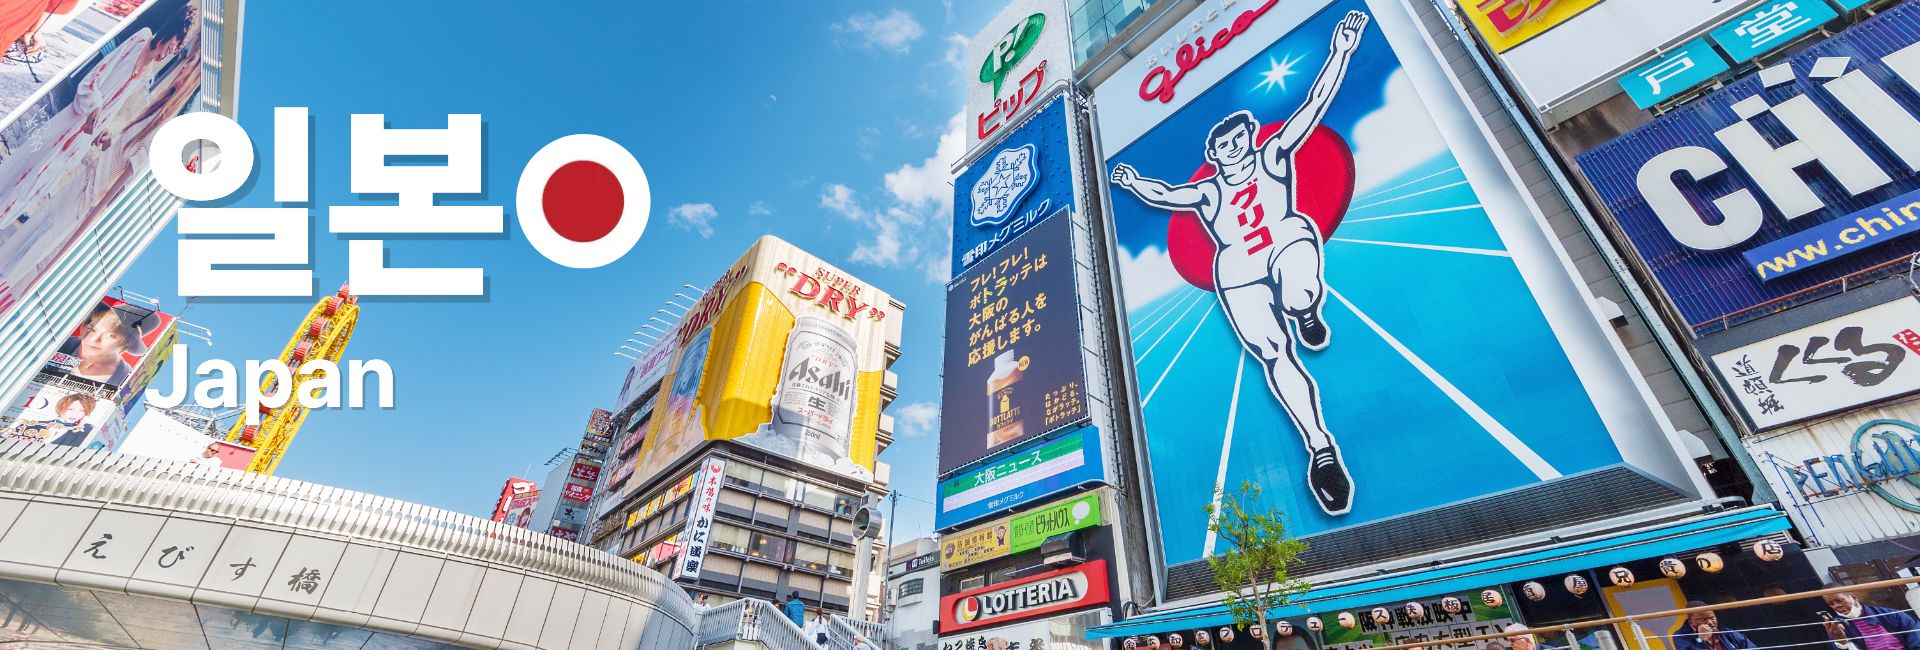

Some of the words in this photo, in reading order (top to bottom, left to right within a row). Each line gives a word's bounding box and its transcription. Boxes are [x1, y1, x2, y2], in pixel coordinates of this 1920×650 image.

[977, 59, 1048, 140] ピップ
[961, 198, 1051, 267] 雪印メグミルク
[1229, 177, 1274, 256] グリコ
[815, 267, 862, 296] SUPER
[969, 254, 1048, 310] ボトラッテは
[968, 296, 1009, 330] 大阪の
[969, 293, 1048, 347] がんばる人を
[788, 357, 851, 401] Asahi
[1768, 326, 1906, 387] くくる
[808, 395, 826, 413] 生
[1731, 354, 1785, 416] 道頓堀
[974, 450, 1043, 488] 大阪ニュース
[83, 533, 322, 596] えびす橋
[918, 555, 936, 567] Toilets
[982, 577, 1074, 614] LOTTERIA
